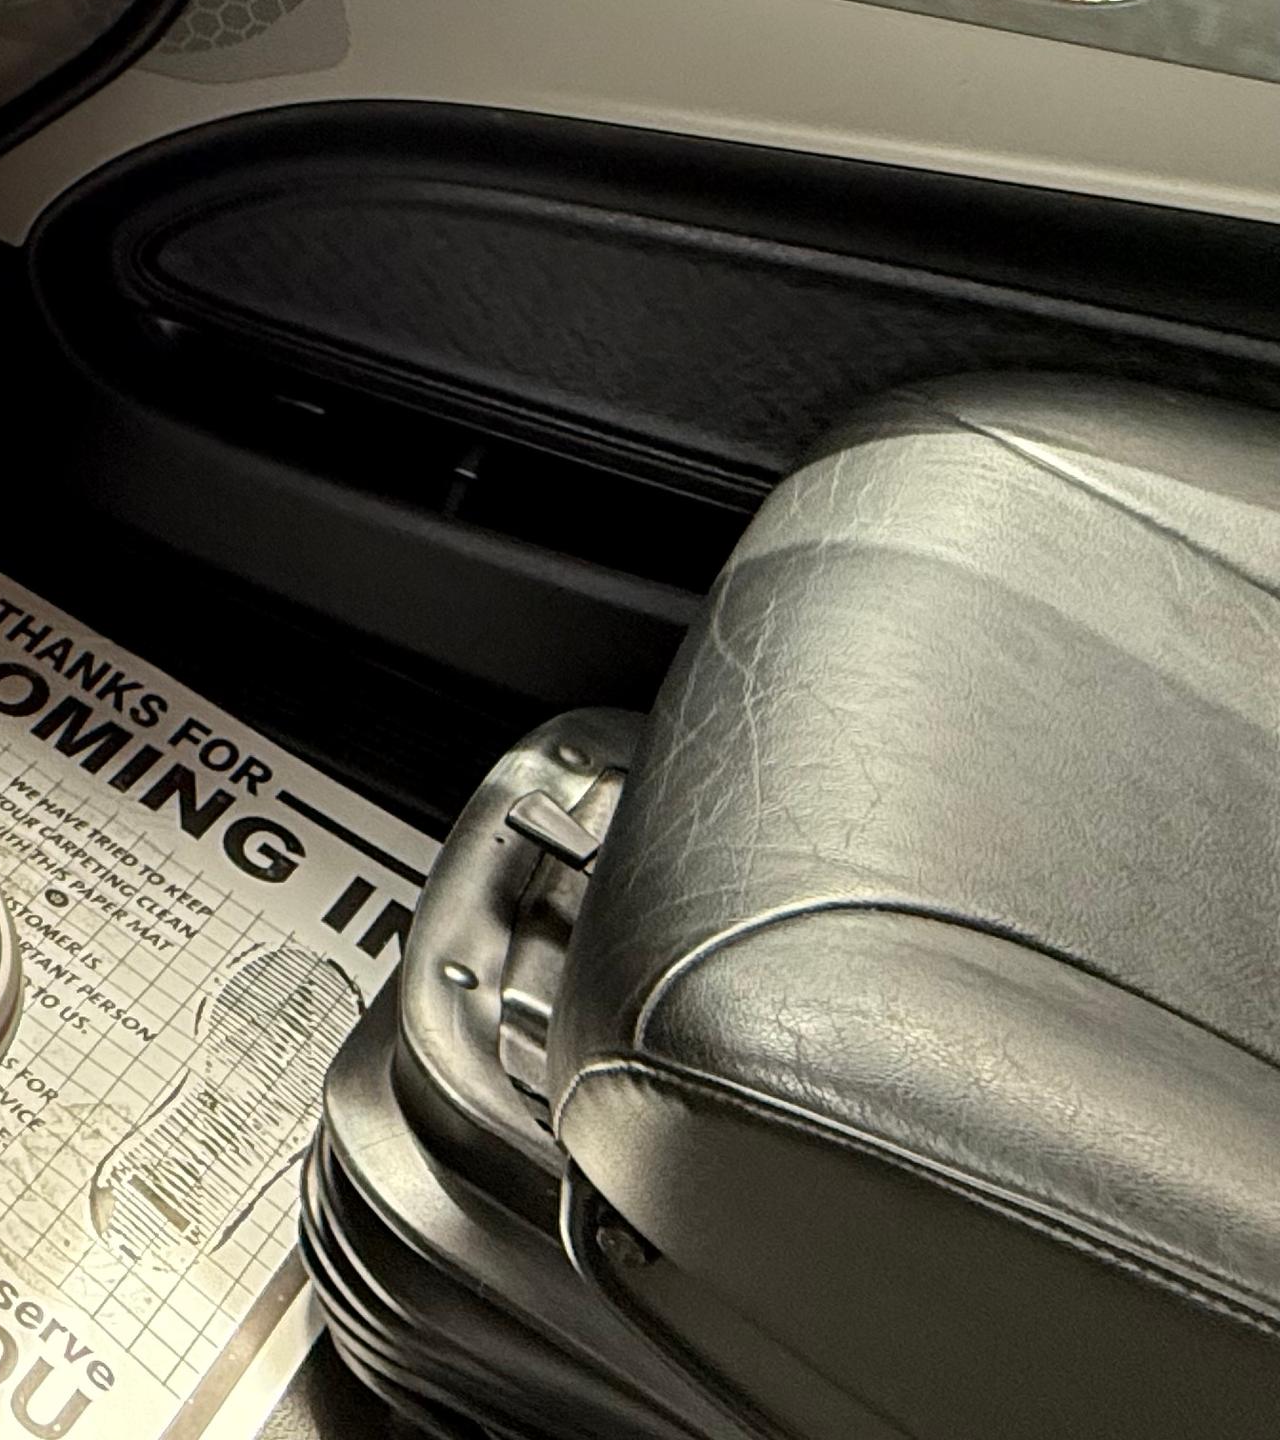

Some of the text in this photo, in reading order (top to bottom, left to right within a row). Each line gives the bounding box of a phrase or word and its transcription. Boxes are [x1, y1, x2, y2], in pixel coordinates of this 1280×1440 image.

[168, 717, 274, 797] FOR
[9, 775, 214, 917] WE HAVE TRIED TO KEEP
[39, 826, 139, 898] CARPETING
[136, 895, 199, 939] CLEAN
[4, 896, 103, 970] STOMER IS
[28, 847, 71, 882] THIS
[68, 879, 129, 921] PAPER
[126, 918, 175, 952] MAT
[17, 937, 159, 1042] RTANT PERSON
[31, 986, 90, 1035] TO US.
[15, 1067, 59, 1101] FOR
